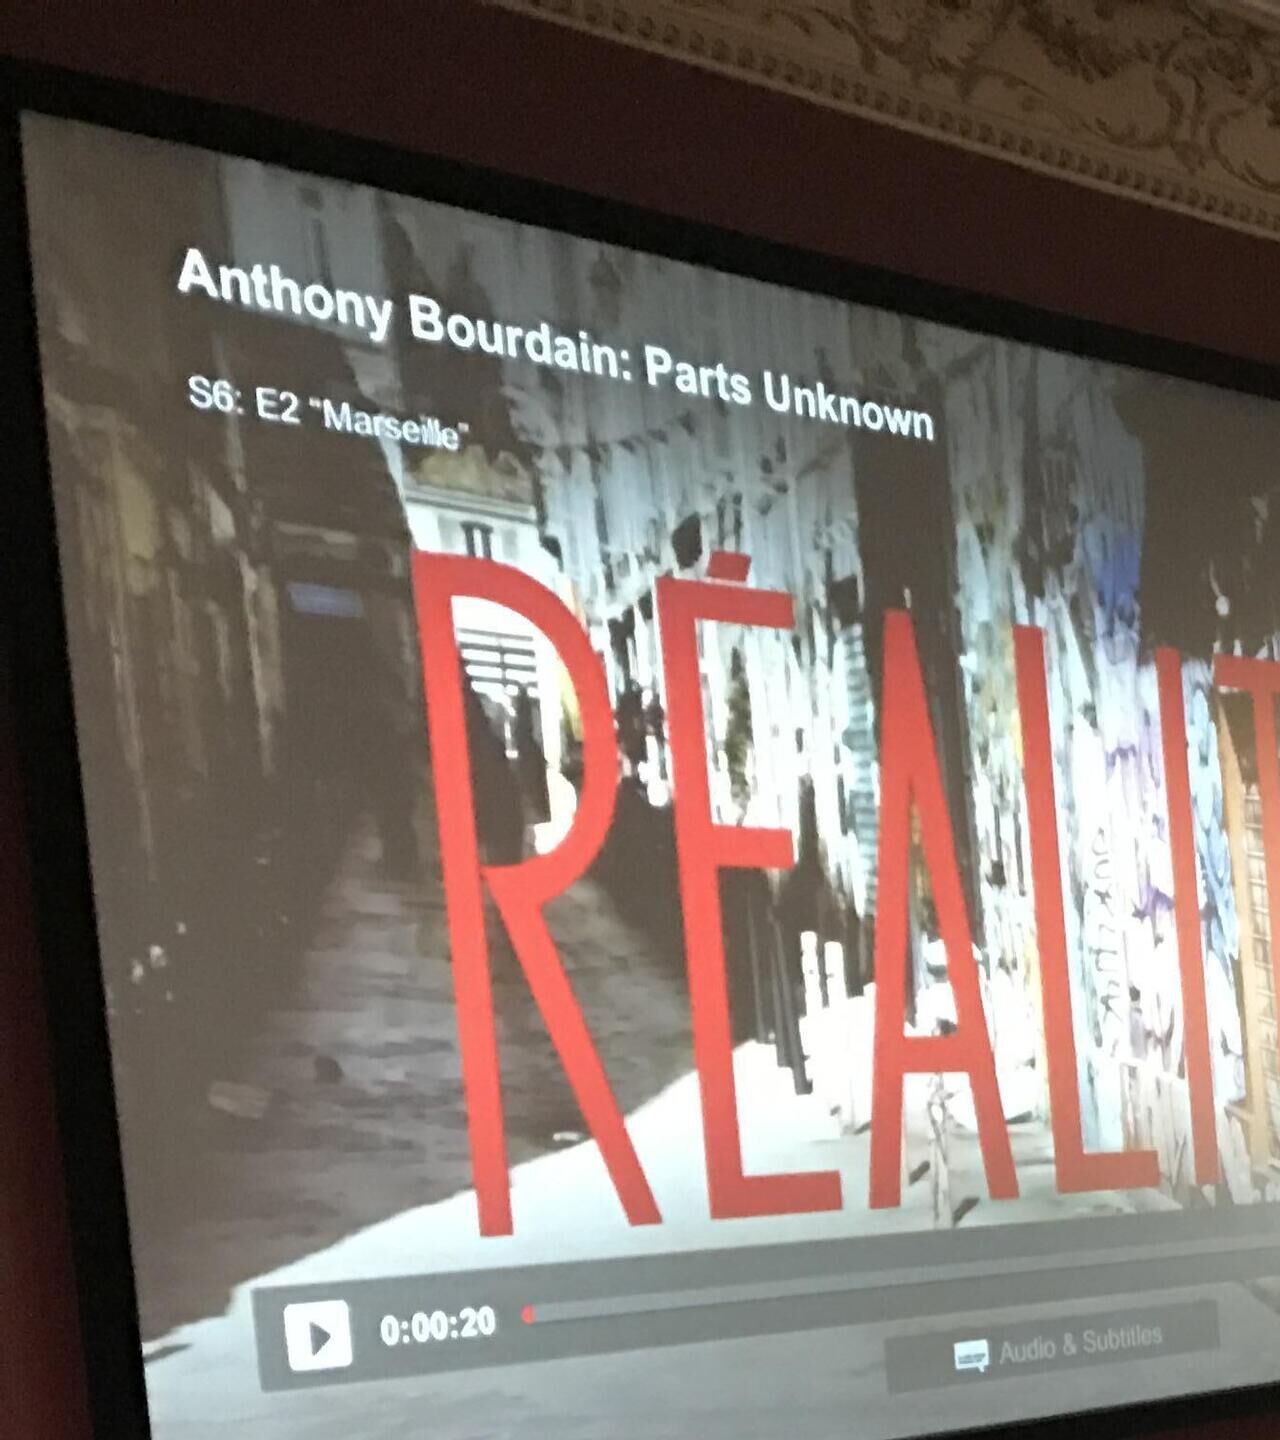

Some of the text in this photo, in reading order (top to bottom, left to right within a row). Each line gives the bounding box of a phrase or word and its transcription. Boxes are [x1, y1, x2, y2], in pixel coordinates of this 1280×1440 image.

[177, 247, 935, 442] Anthony Bourdain: Parts Unknown
[188, 374, 470, 451] S6: E2 "Marseille"
[380, 1305, 496, 1346] 0:00:20
[1000, 1324, 1163, 1365] Audio & Subtitles
